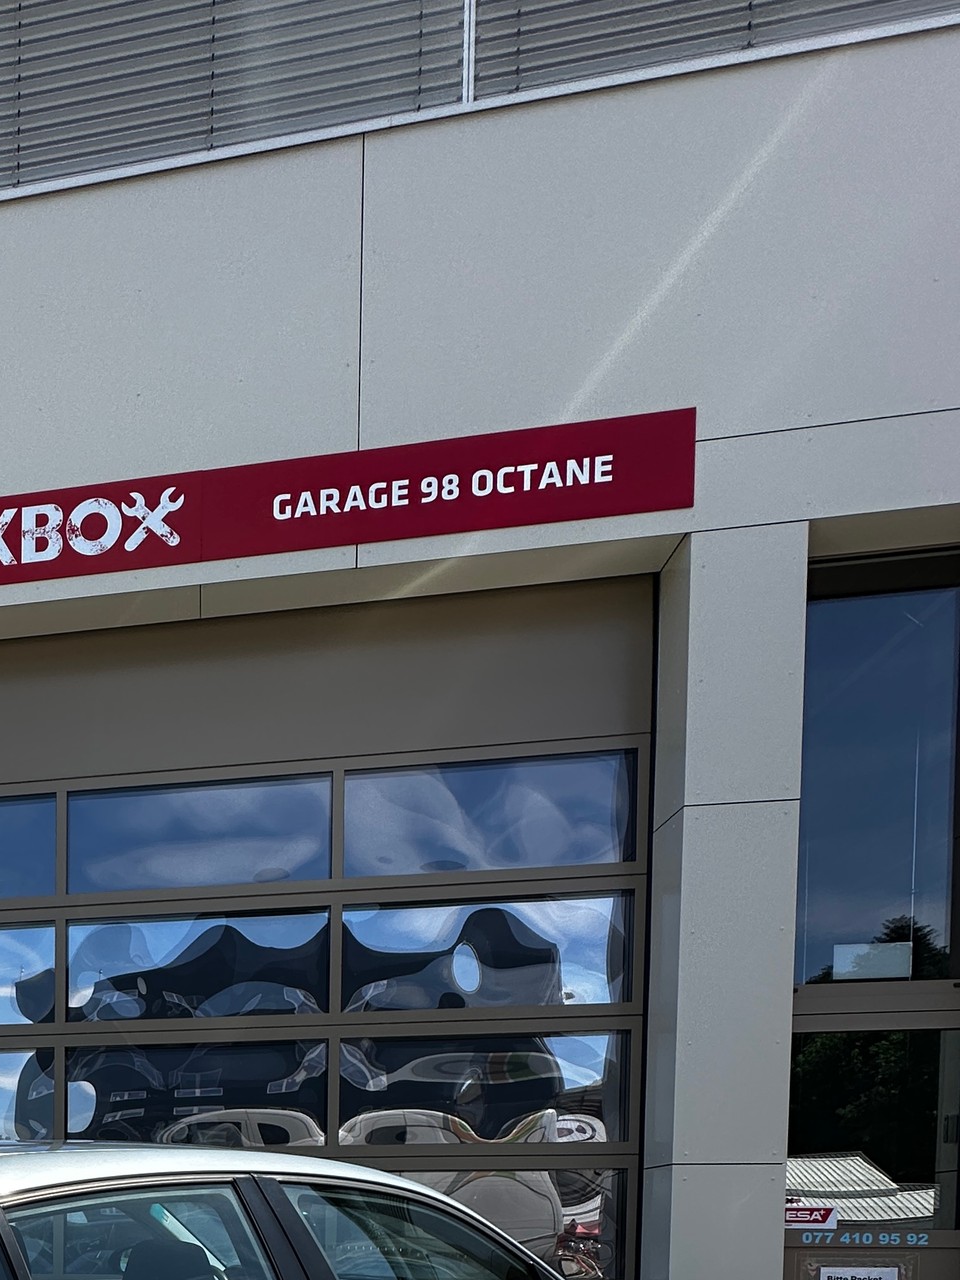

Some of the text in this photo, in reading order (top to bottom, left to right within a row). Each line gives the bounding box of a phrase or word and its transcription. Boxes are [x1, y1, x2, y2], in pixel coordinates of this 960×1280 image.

[273, 454, 614, 520] GARAGE 98 OCTANE
[802, 1232, 929, 1245] 077 410 95 92
